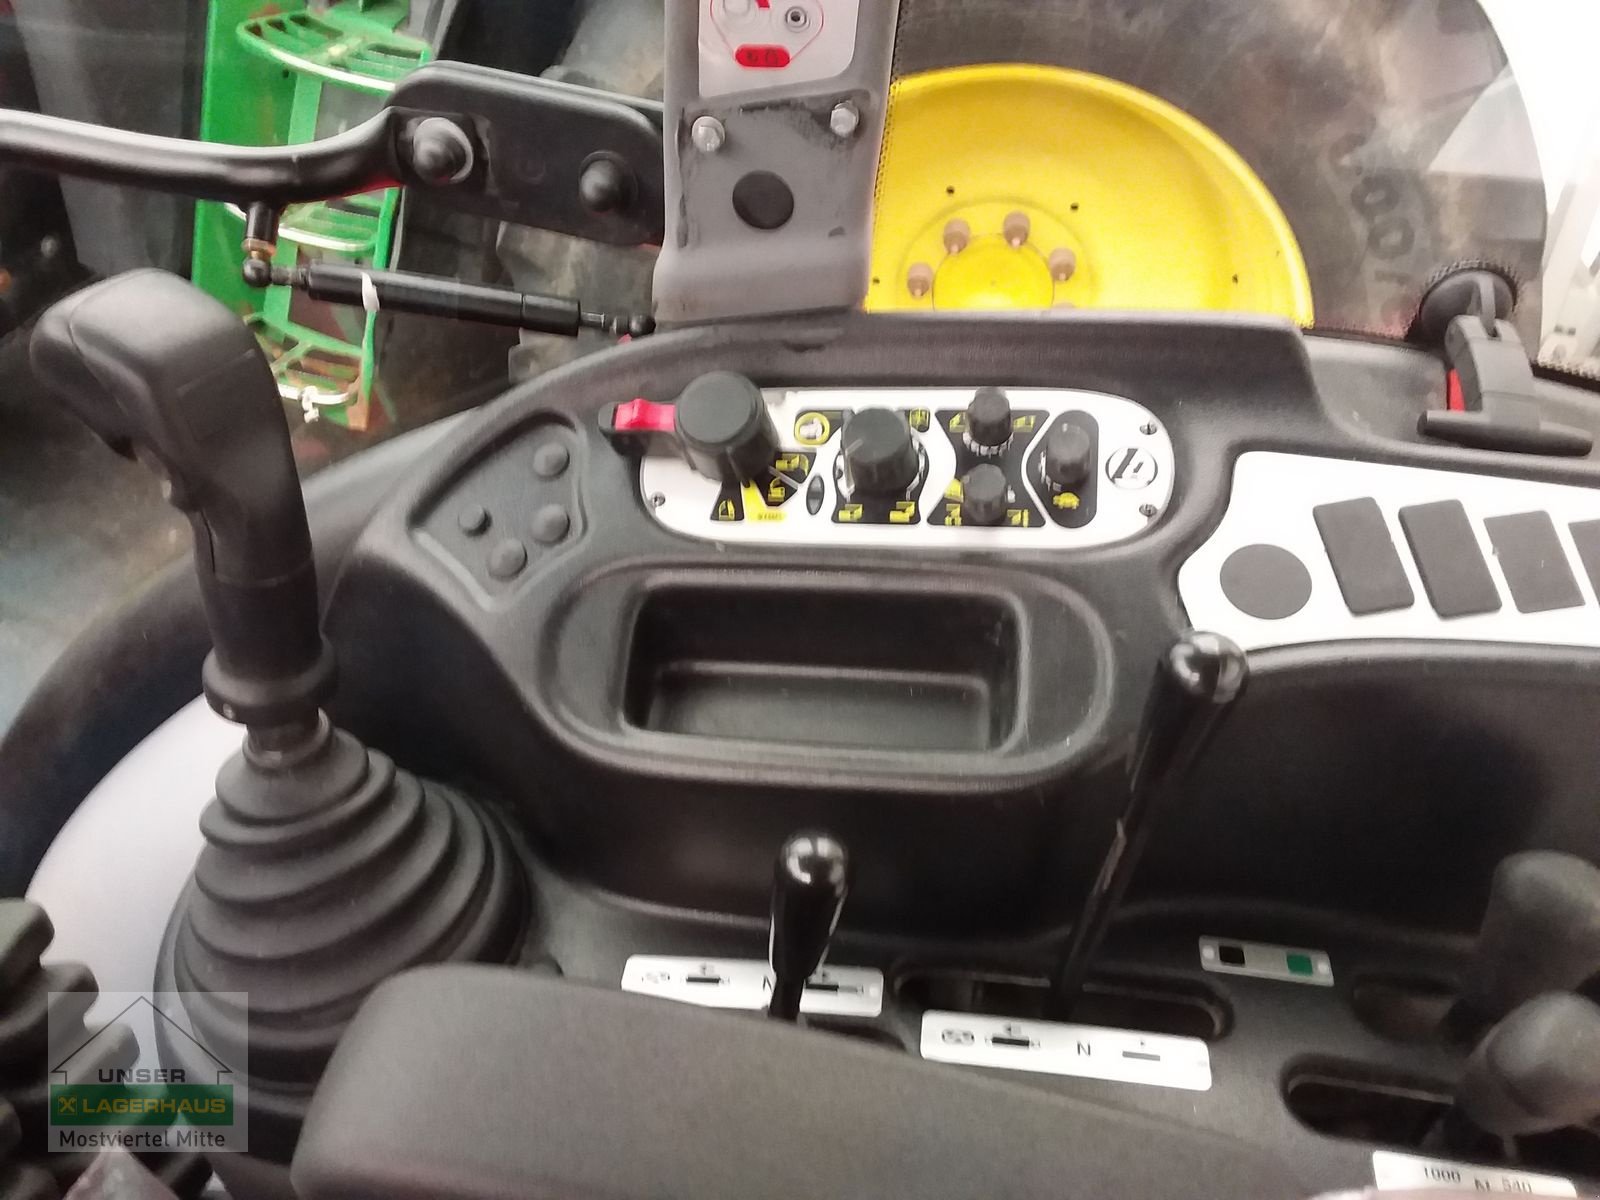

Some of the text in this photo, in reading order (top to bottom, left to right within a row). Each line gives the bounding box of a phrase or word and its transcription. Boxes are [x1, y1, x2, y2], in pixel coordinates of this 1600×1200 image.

[1076, 1041, 1091, 1056] N
[1424, 1167, 1462, 1183] 1000
[1503, 1176, 1534, 1194] 540
